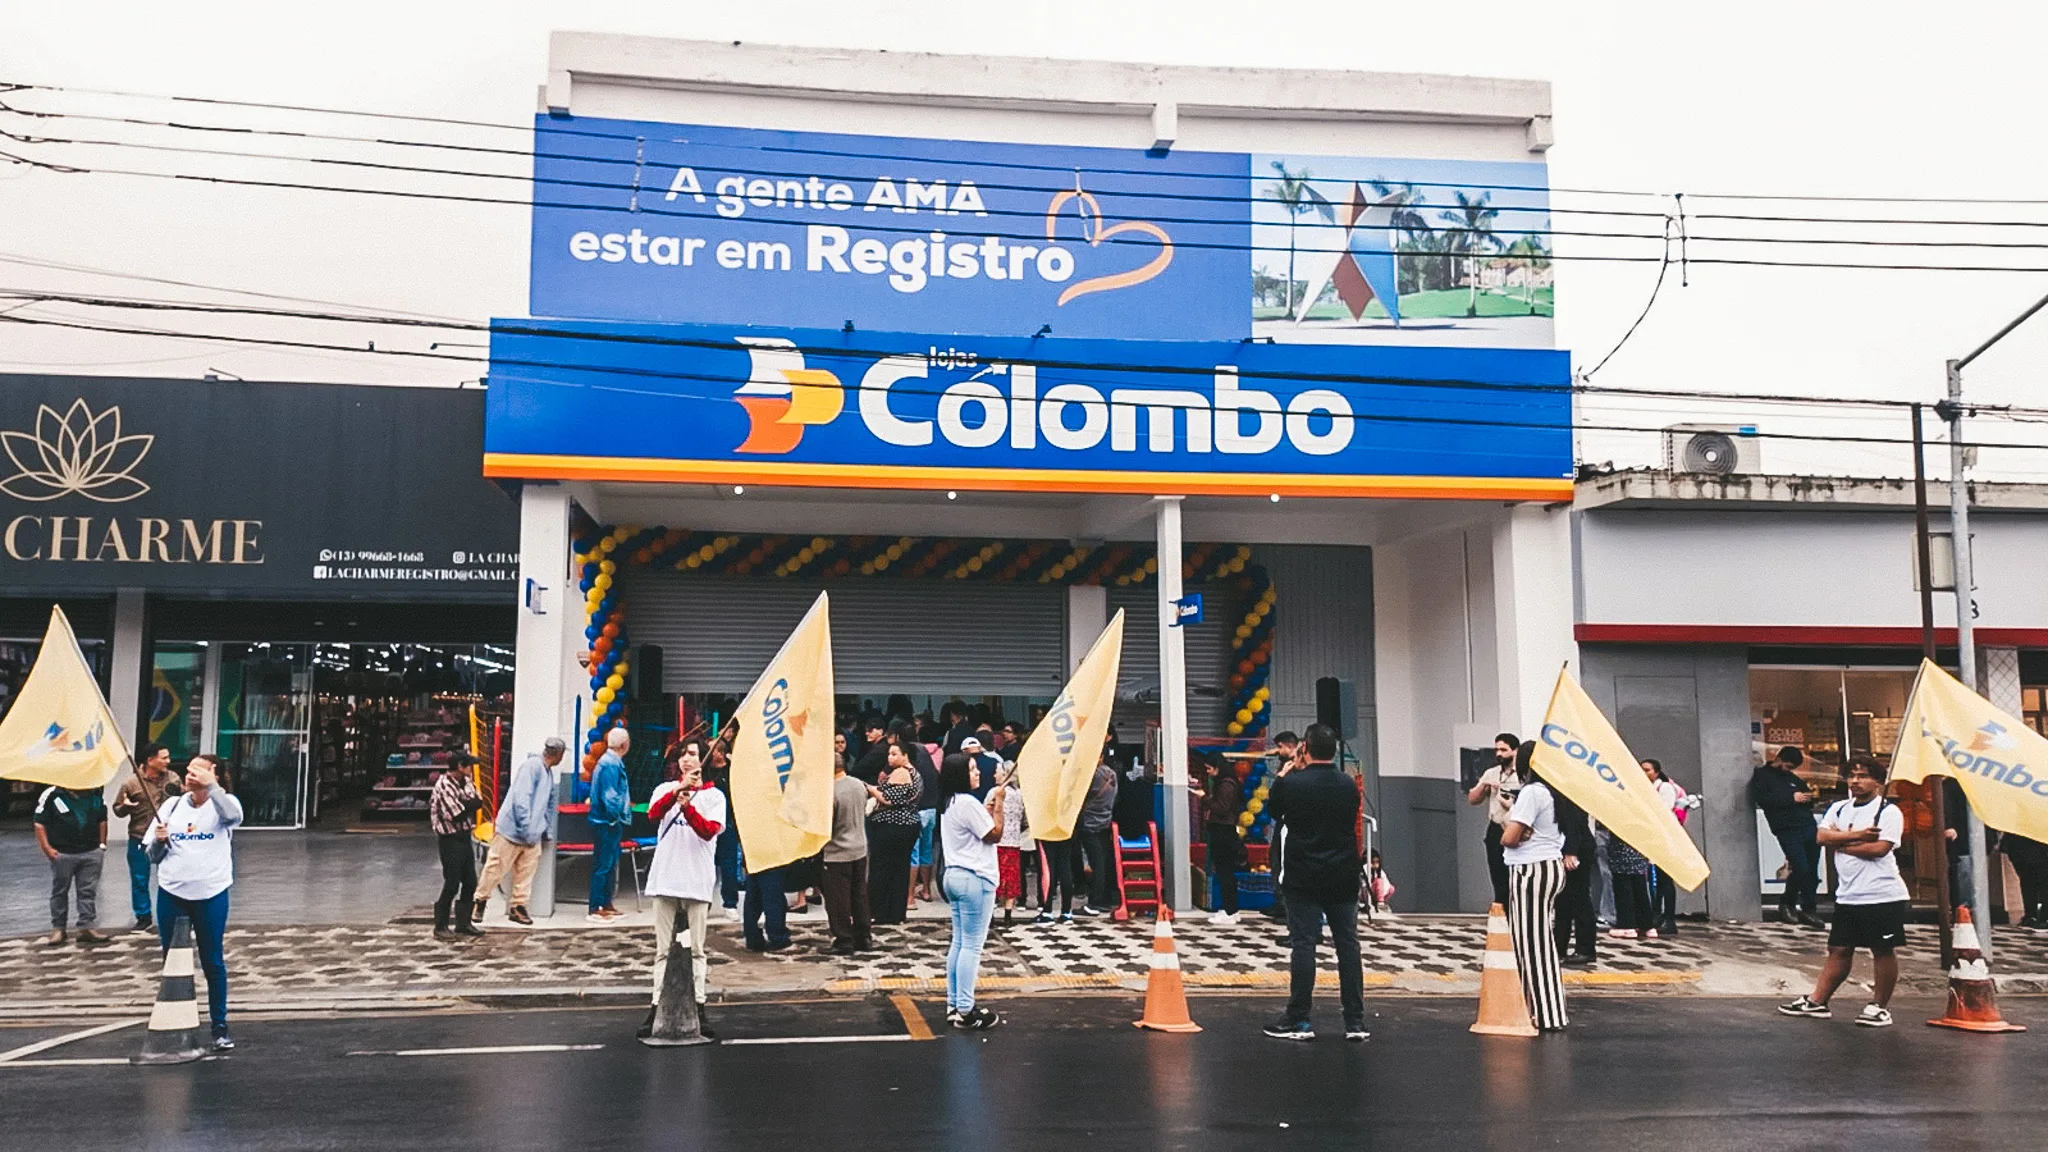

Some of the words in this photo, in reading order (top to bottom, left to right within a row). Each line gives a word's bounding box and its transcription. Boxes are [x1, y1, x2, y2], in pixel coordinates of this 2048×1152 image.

[665, 167, 704, 201] A
[715, 175, 855, 219] gente
[863, 175, 988, 217] AMA
[569, 228, 706, 267] estar
[716, 239, 792, 270] em
[806, 224, 1075, 293] Registro
[929, 346, 978, 370] lojas
[858, 353, 1355, 456] Colombo
[4, 514, 265, 564] CHARME
[468, 552, 485, 564] LA
